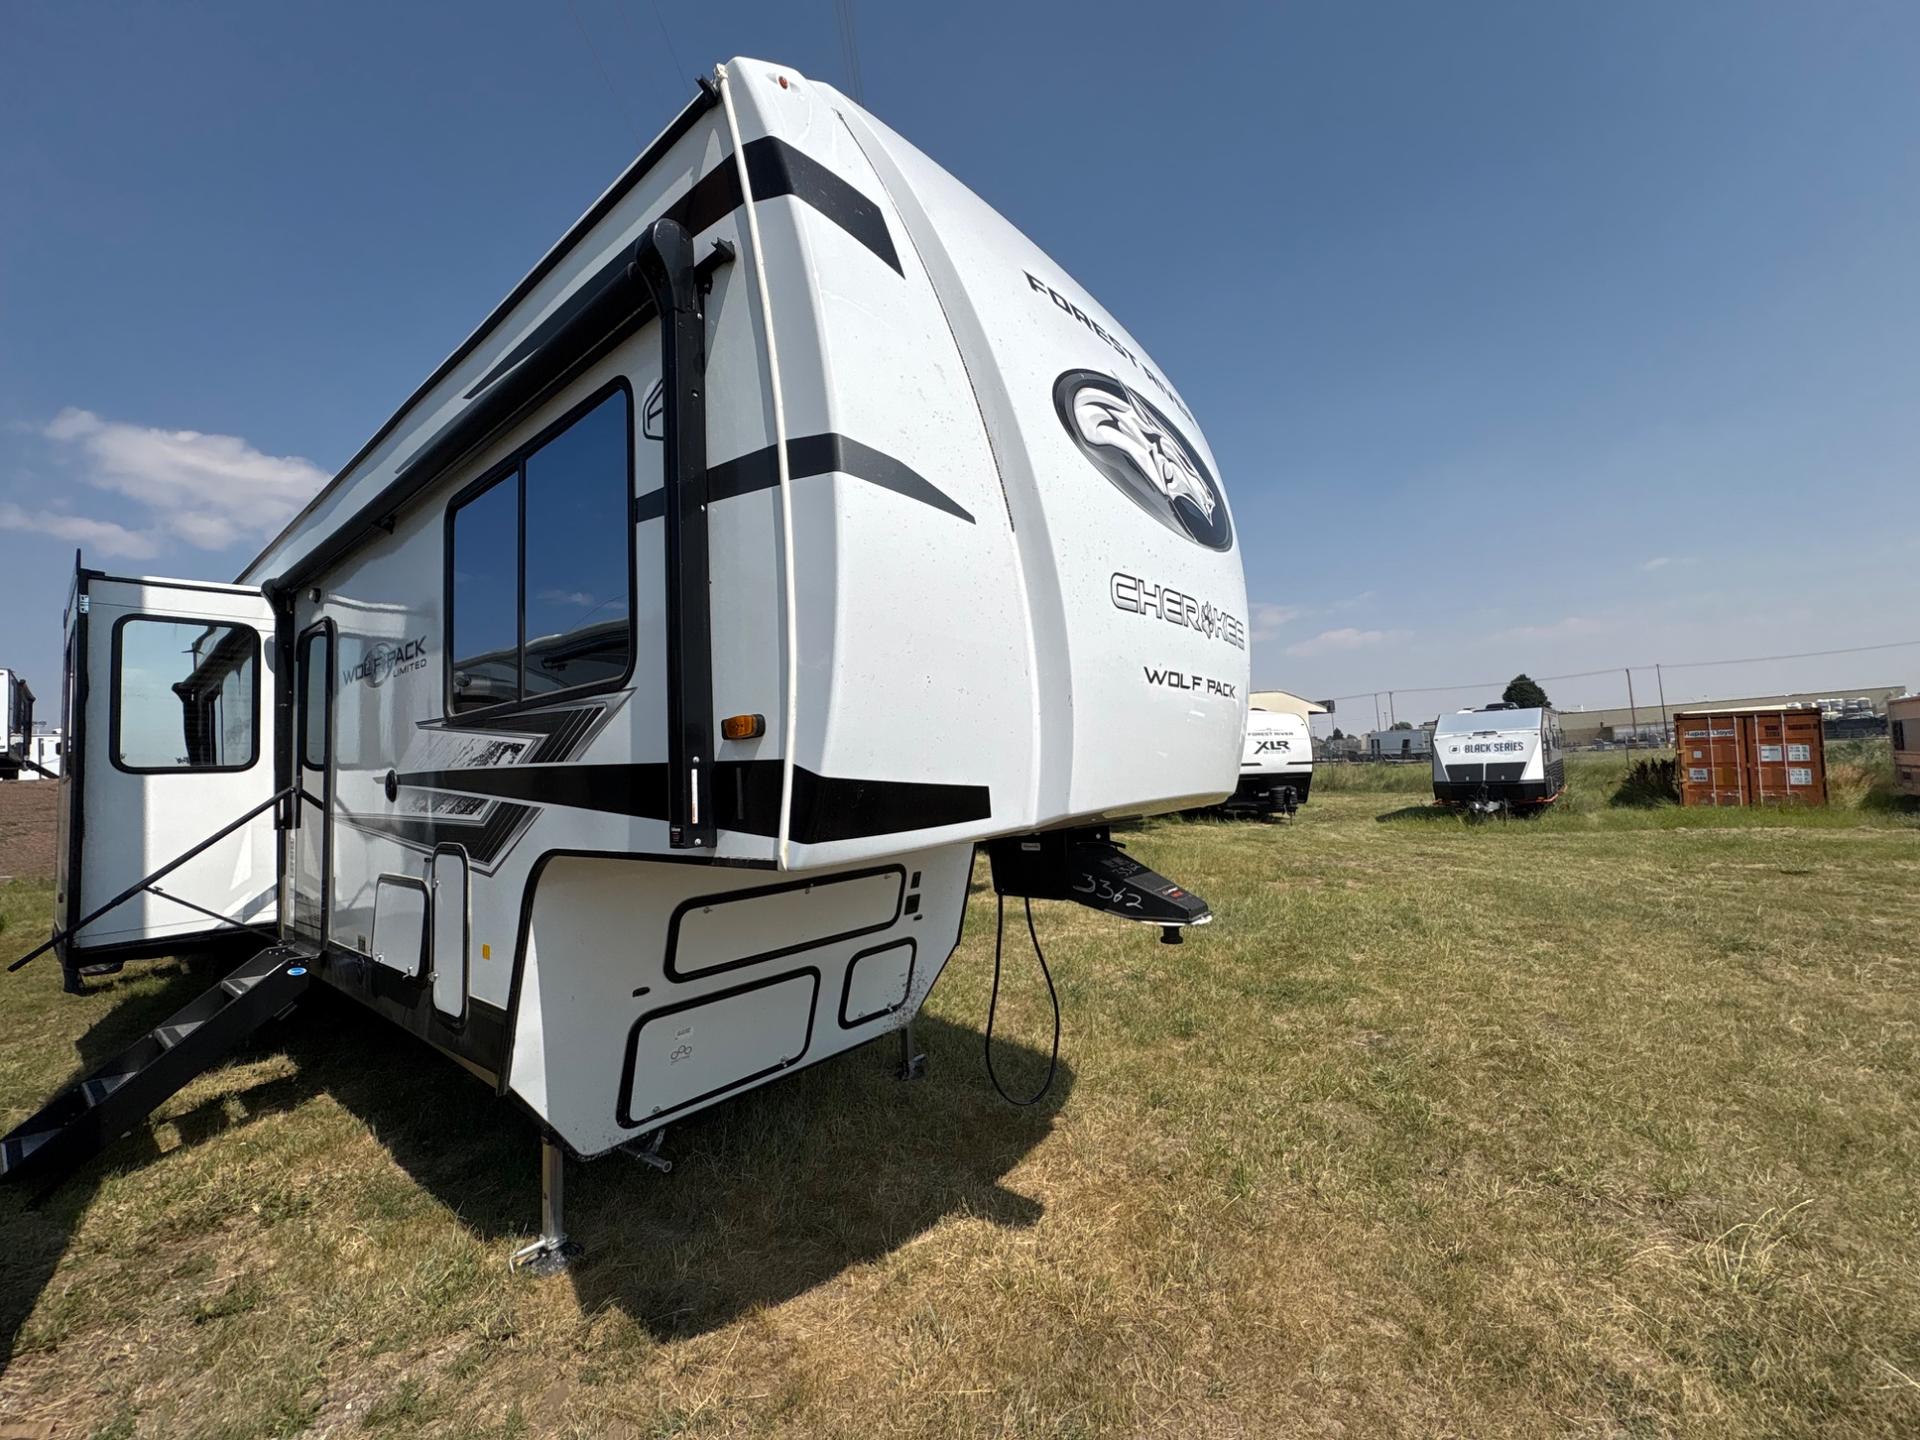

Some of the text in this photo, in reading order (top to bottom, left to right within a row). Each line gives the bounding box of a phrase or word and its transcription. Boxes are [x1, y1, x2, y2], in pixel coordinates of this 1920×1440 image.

[1022, 269, 1138, 368] FOREST
[343, 634, 427, 686] WOLF PACK
[392, 658, 427, 678] LIMITED
[1143, 666, 1237, 699] WOLF PACK
[1253, 740, 1291, 755] XLR
[1464, 741, 1525, 753] BLACK SERIES
[1072, 872, 1144, 910] 3362
